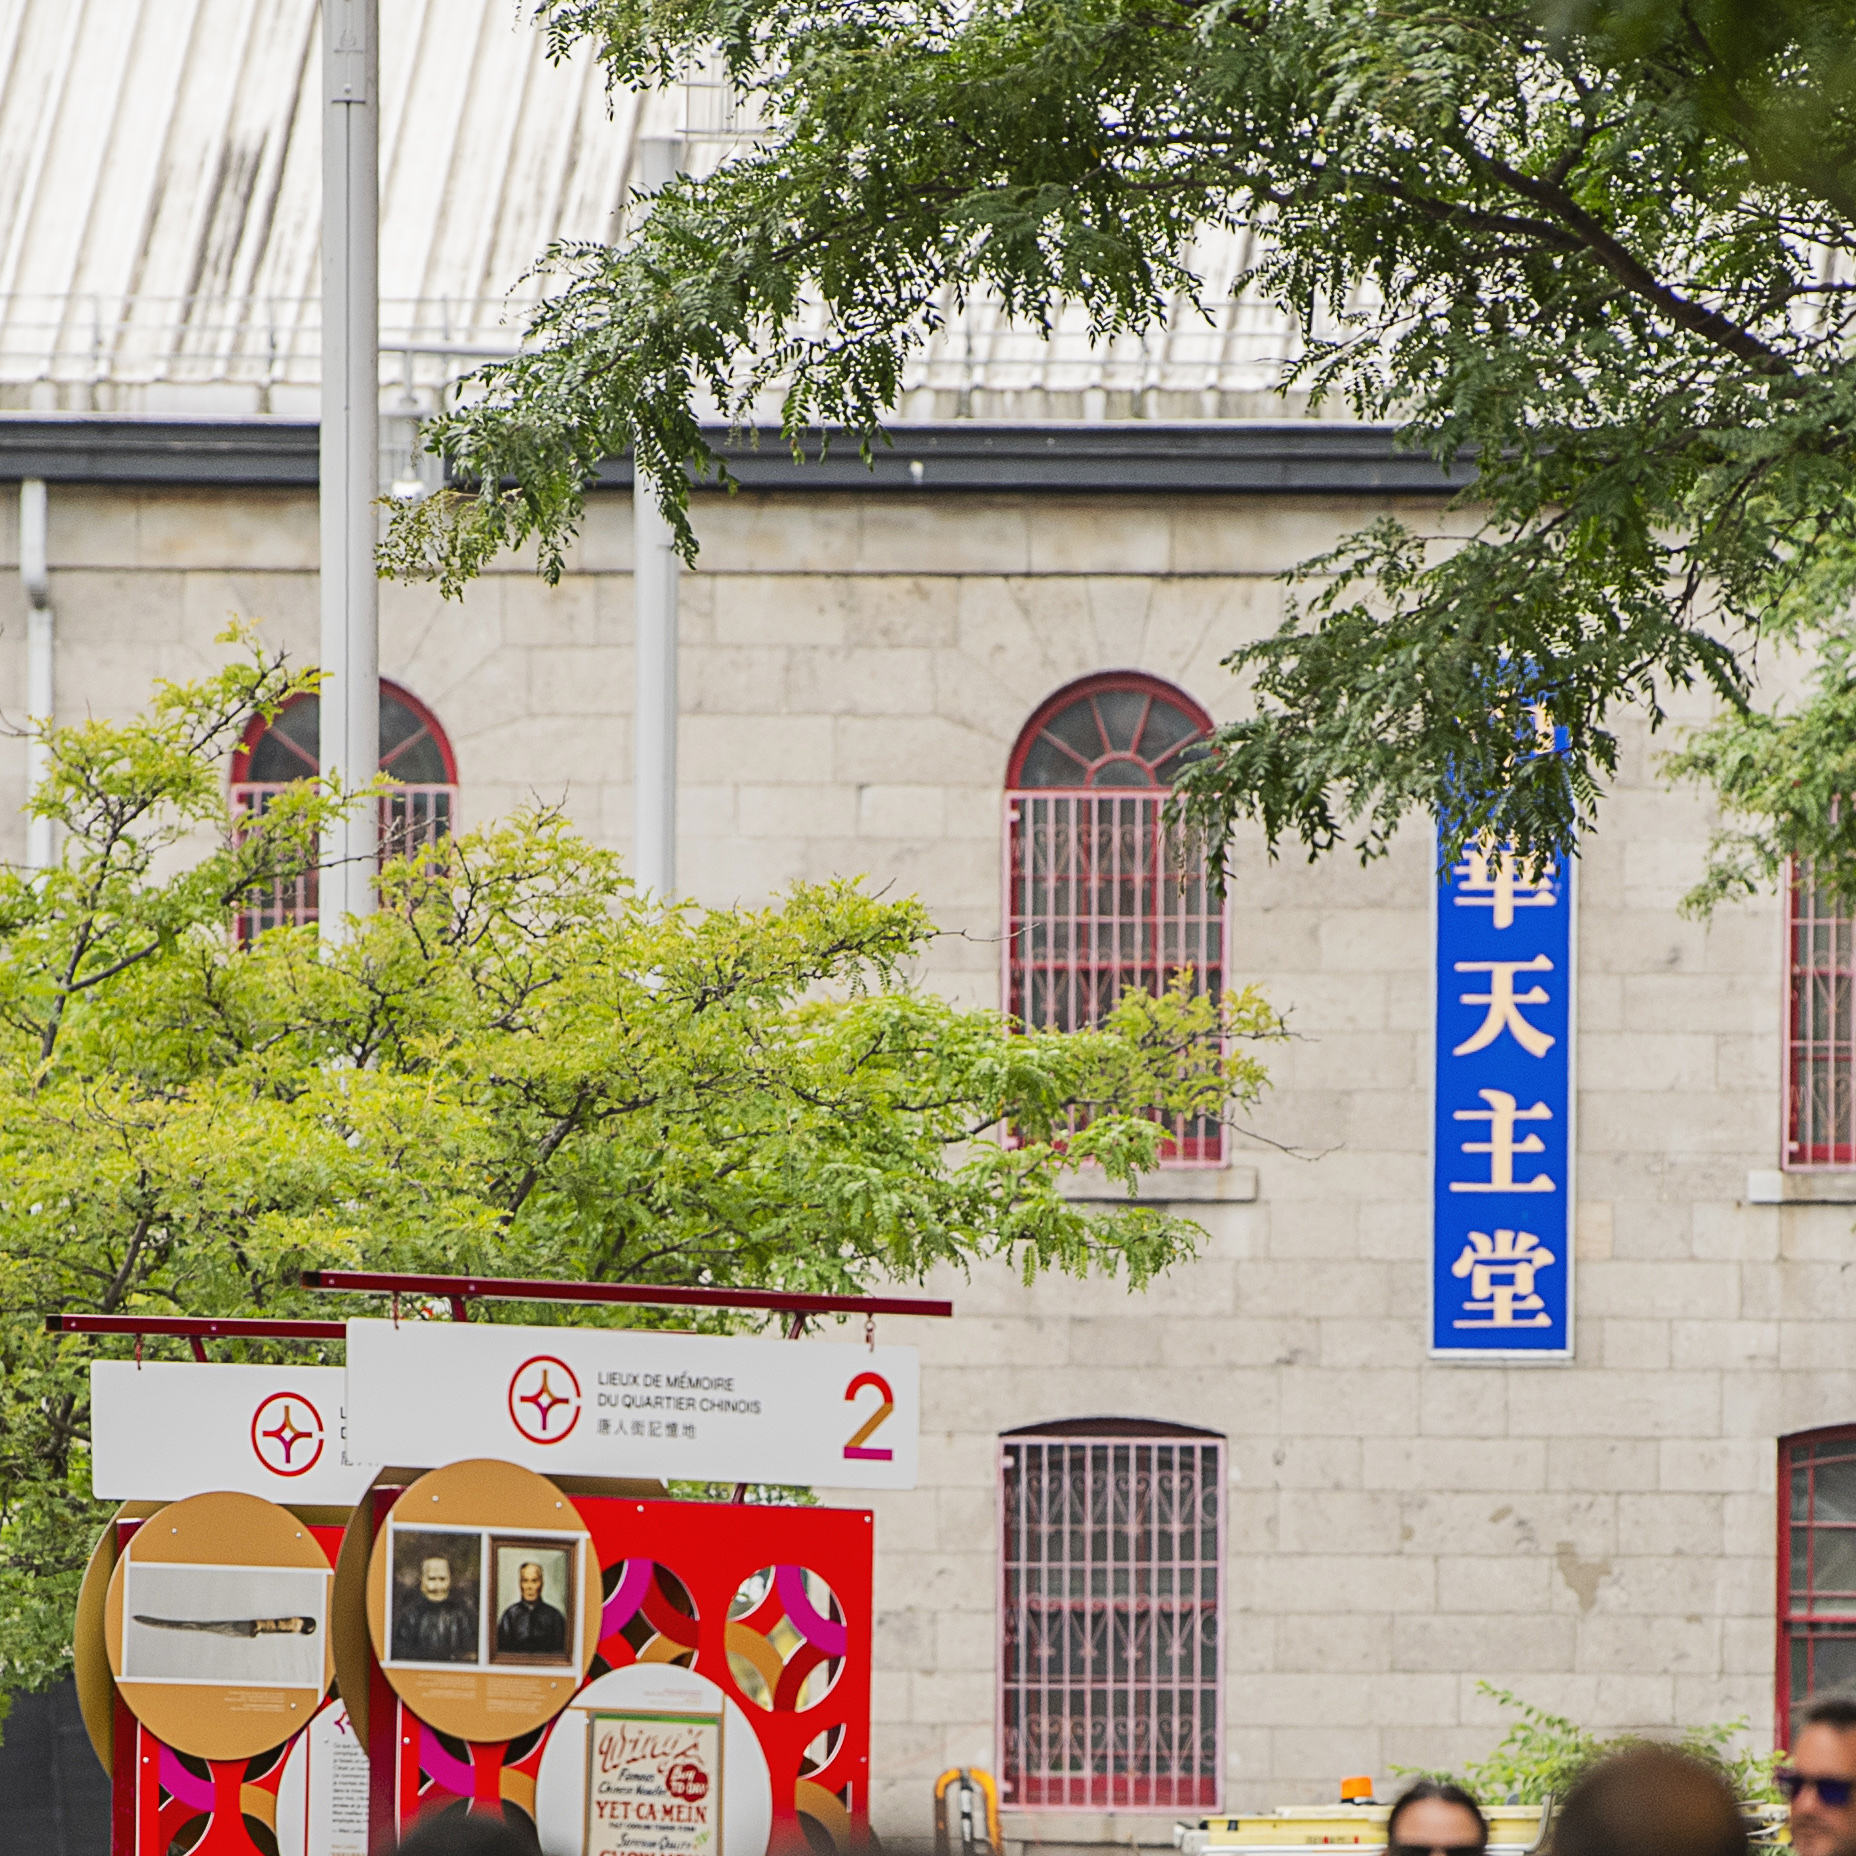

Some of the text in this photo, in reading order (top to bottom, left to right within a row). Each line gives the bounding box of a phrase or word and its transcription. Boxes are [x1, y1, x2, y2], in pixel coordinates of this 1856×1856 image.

[597, 1370, 735, 1392] LIEUX DE MÉMOIRE
[597, 1392, 763, 1415] DU QUARTIER CHINOIS
[844, 1371, 894, 1461] 2
